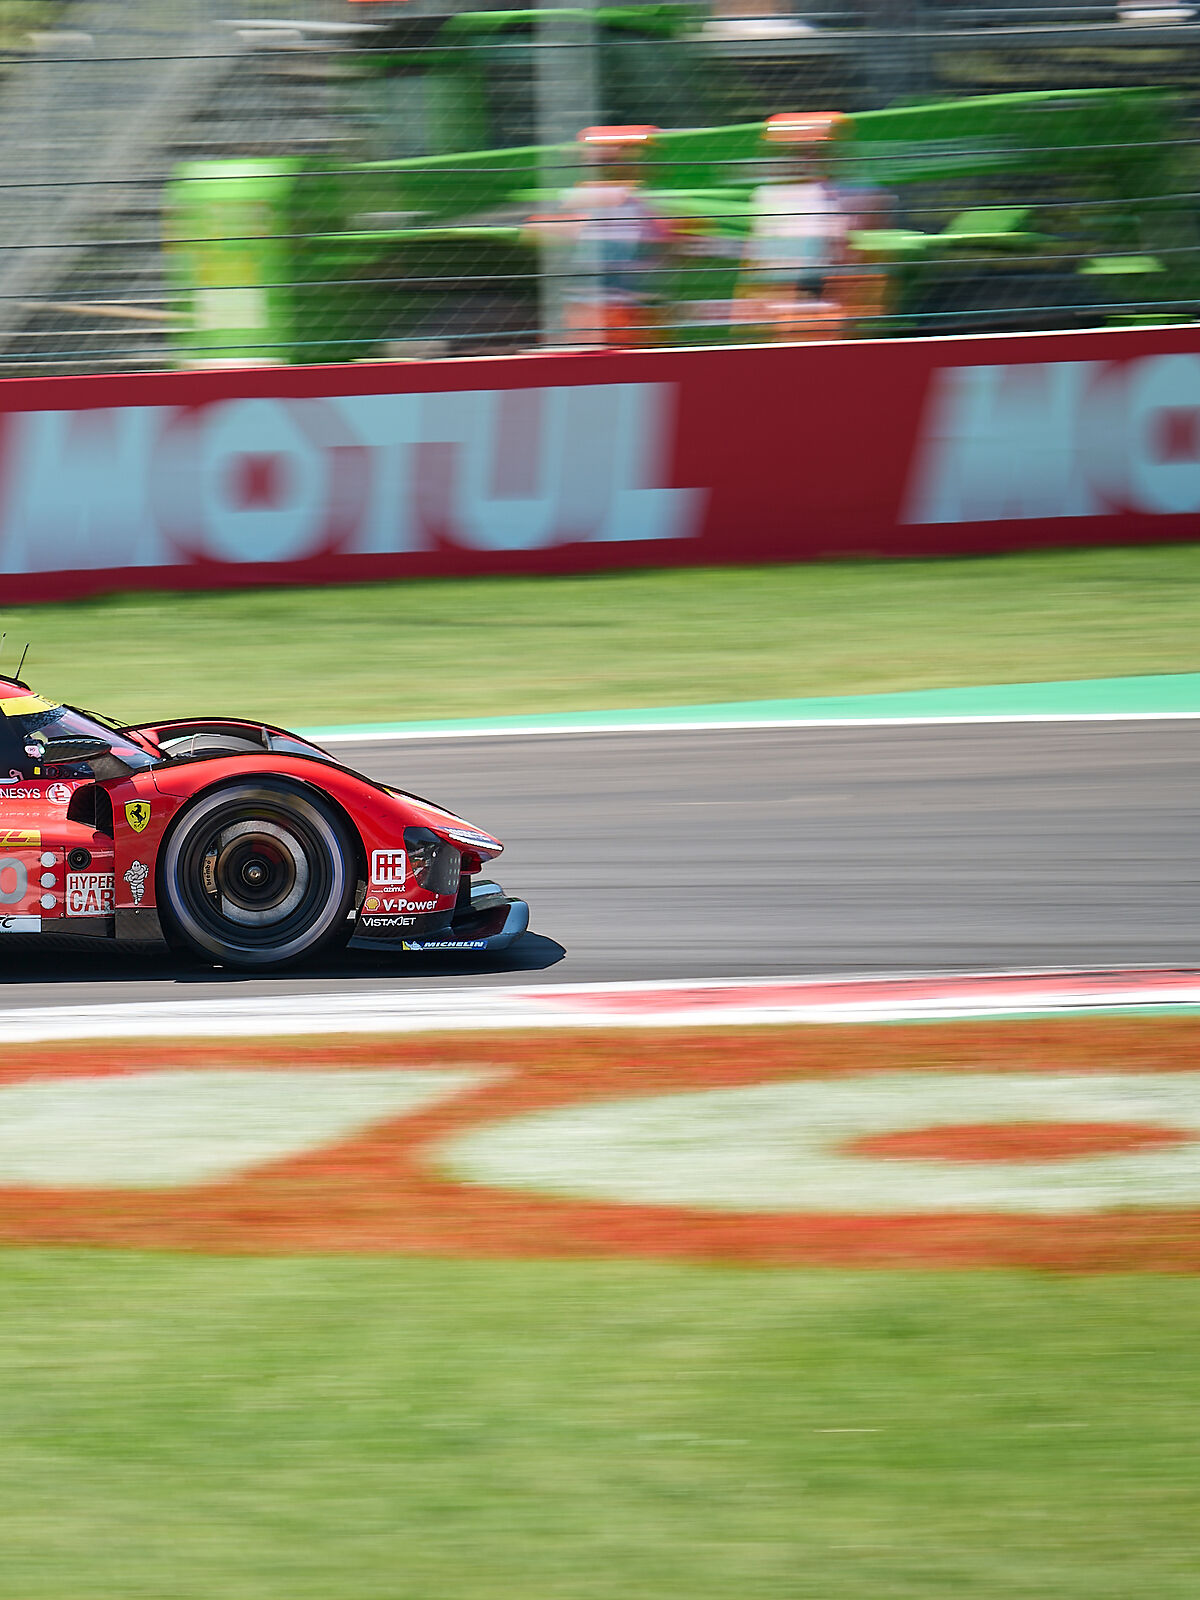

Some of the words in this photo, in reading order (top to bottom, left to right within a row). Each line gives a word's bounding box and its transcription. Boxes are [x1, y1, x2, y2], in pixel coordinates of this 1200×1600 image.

[69, 875, 114, 889] HYPER
[70, 889, 114, 912] CAR
[382, 899, 438, 911] V-Power
